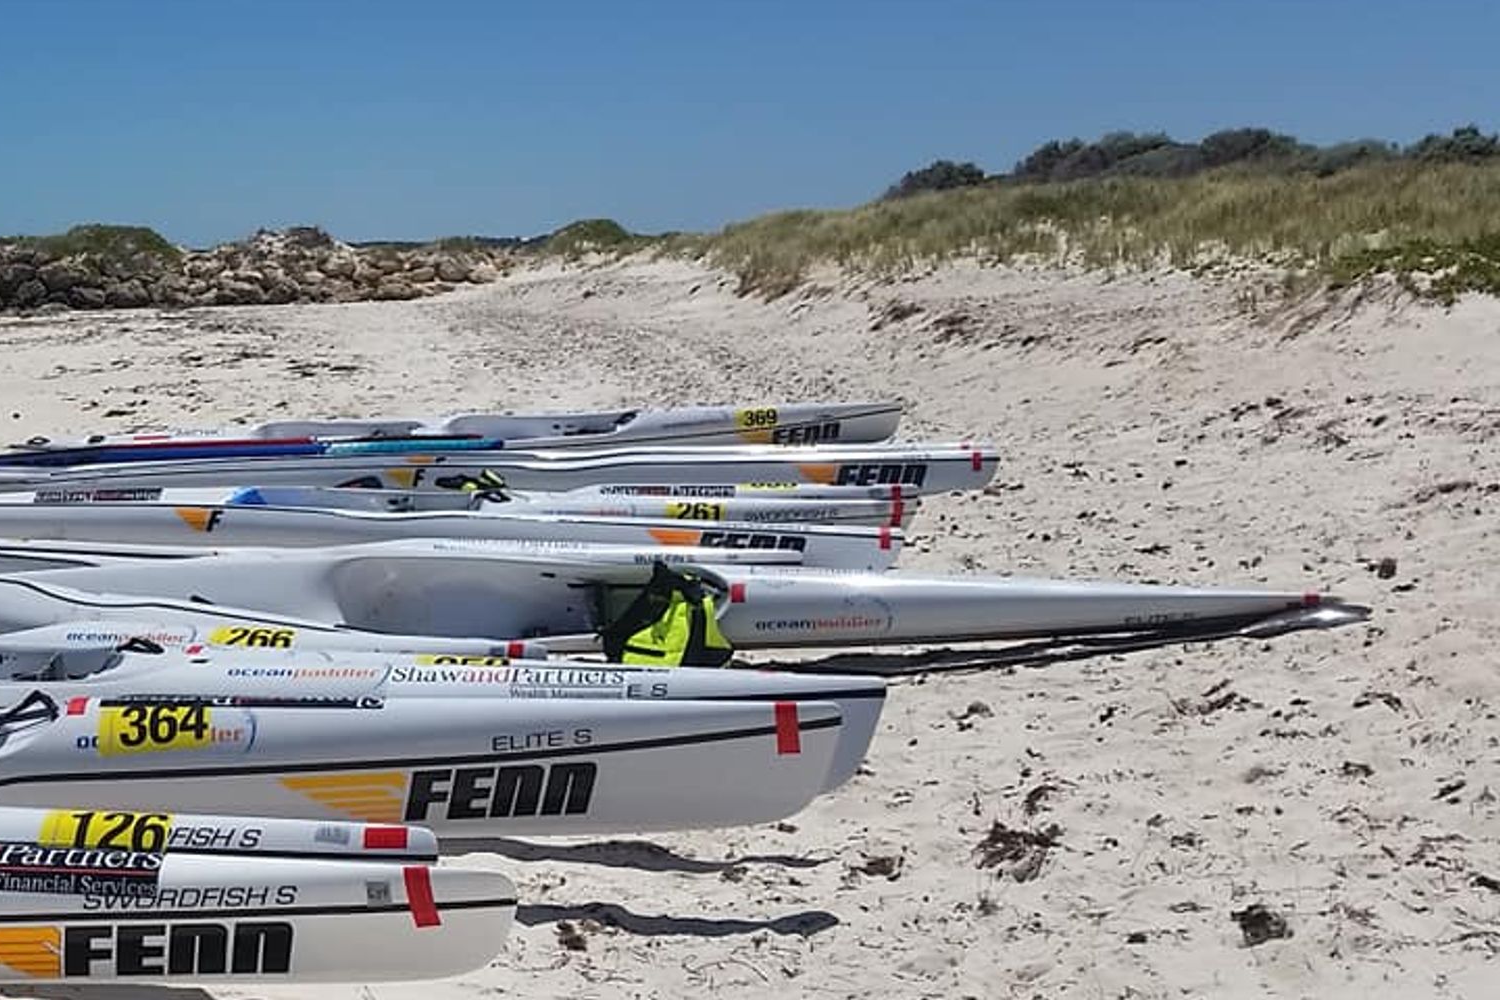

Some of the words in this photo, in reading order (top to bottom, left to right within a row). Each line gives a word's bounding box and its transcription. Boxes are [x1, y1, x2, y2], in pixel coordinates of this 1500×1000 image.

[743, 408, 778, 427] 369
[224, 628, 295, 648] 266
[118, 703, 208, 747] 364
[492, 731, 564, 751] ELITE
[573, 728, 592, 744] S
[403, 762, 598, 821] FENN
[68, 811, 169, 852] 126
[239, 828, 262, 848] S
[79, 874, 160, 899] Services
[83, 886, 269, 911] SWORDFISH
[274, 885, 301, 905] S
[64, 922, 294, 977] FENN
